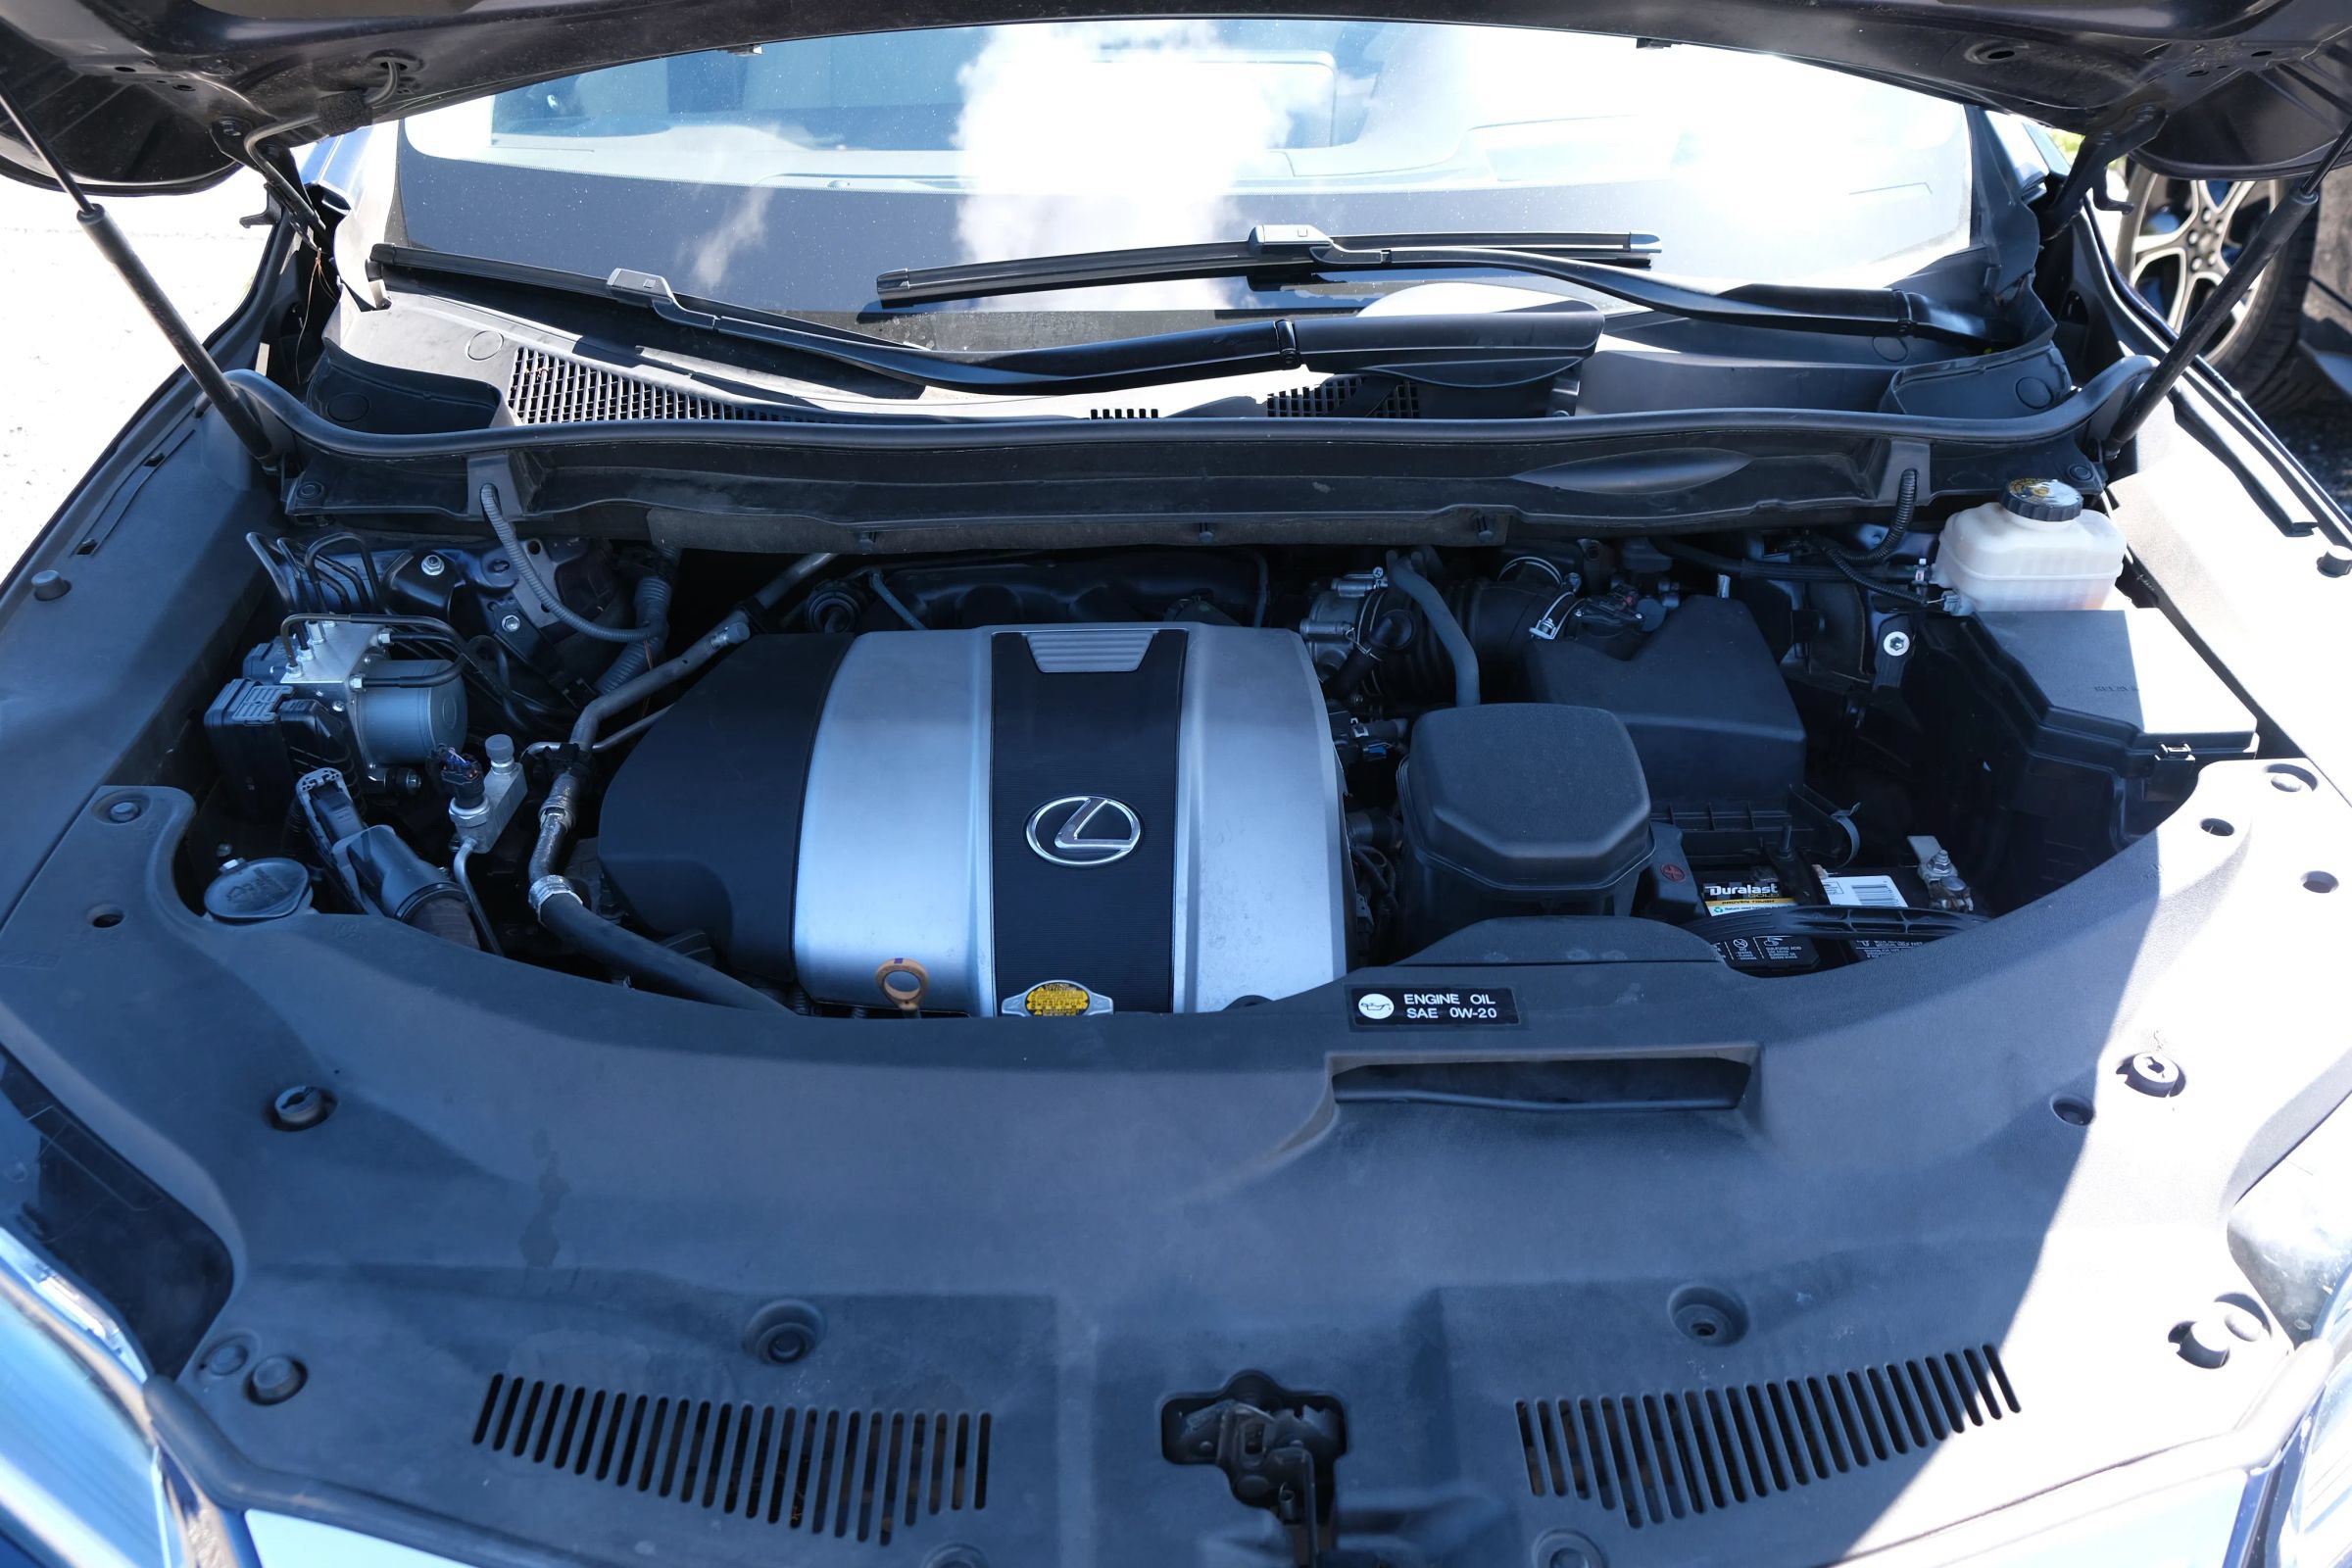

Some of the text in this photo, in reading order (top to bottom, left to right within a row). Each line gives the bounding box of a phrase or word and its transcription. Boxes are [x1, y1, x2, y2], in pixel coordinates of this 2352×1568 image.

[1704, 883, 1779, 896] Duralast
[1403, 994, 1495, 1004] ENGINE OIL
[1406, 1006, 1497, 1019] SAE 0W-20
